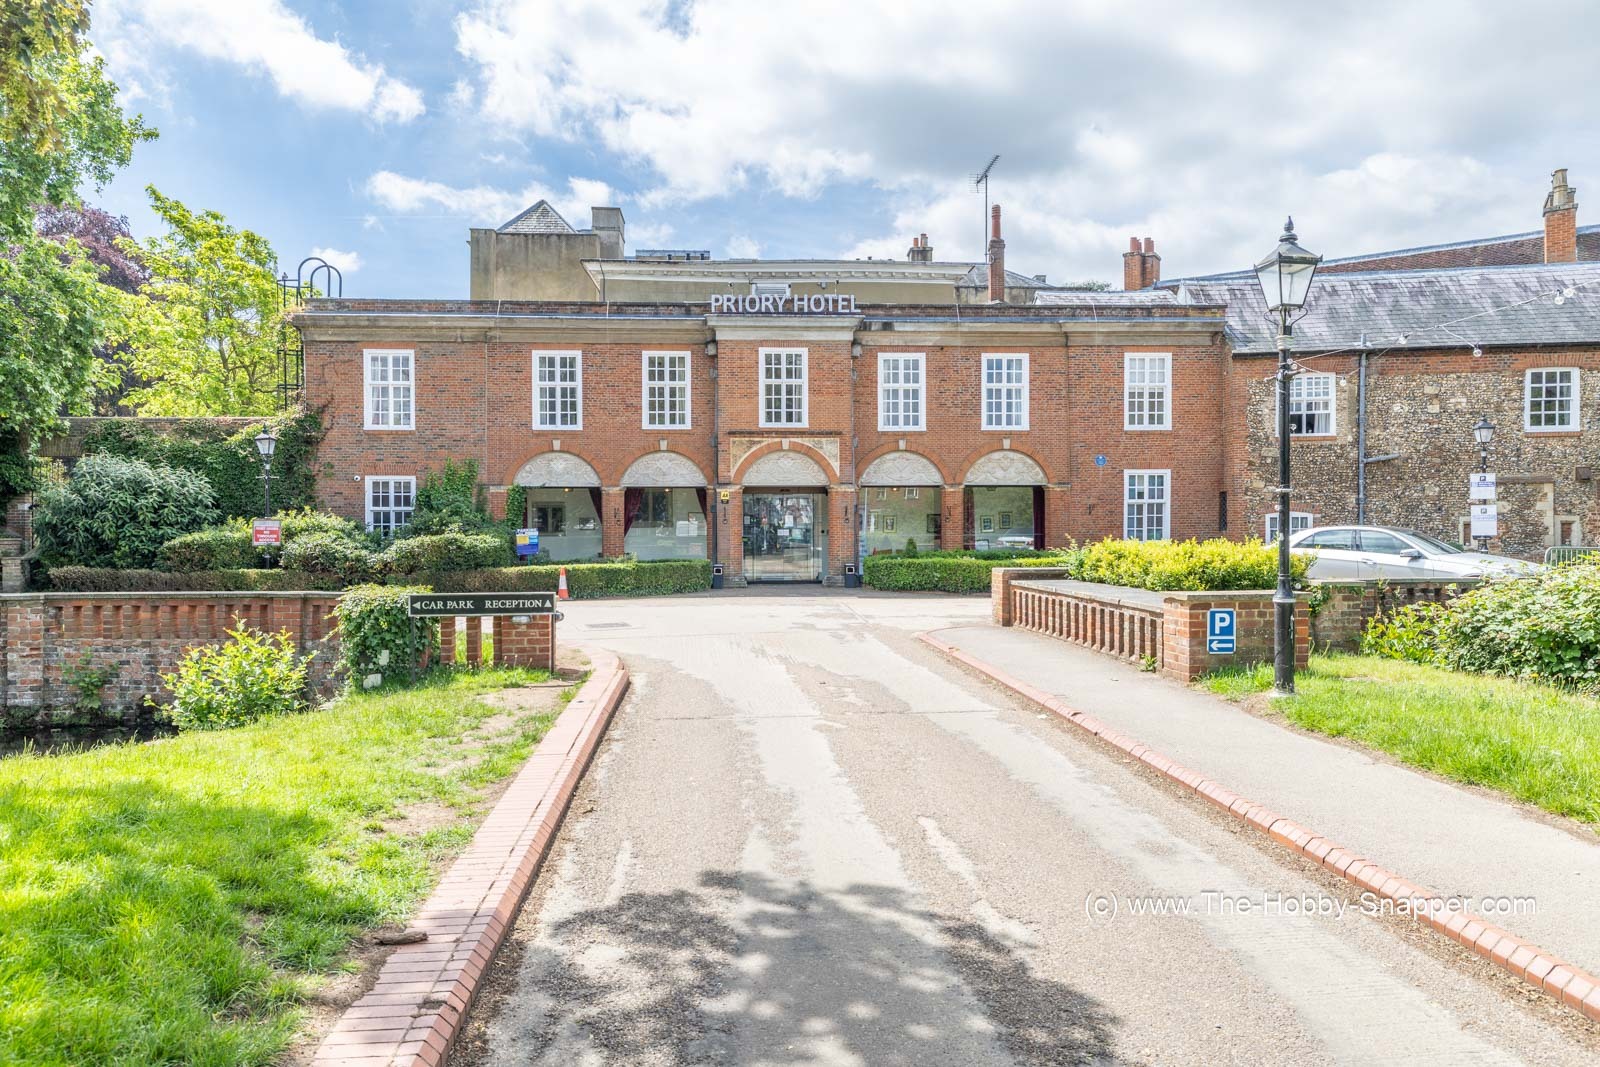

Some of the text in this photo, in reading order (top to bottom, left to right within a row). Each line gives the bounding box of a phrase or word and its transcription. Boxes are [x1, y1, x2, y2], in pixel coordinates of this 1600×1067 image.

[711, 294, 861, 313] PRIORY HOTEL
[421, 600, 474, 609] CAR PARK
[485, 600, 542, 608] RECEPTION
[1215, 613, 1230, 634] P
